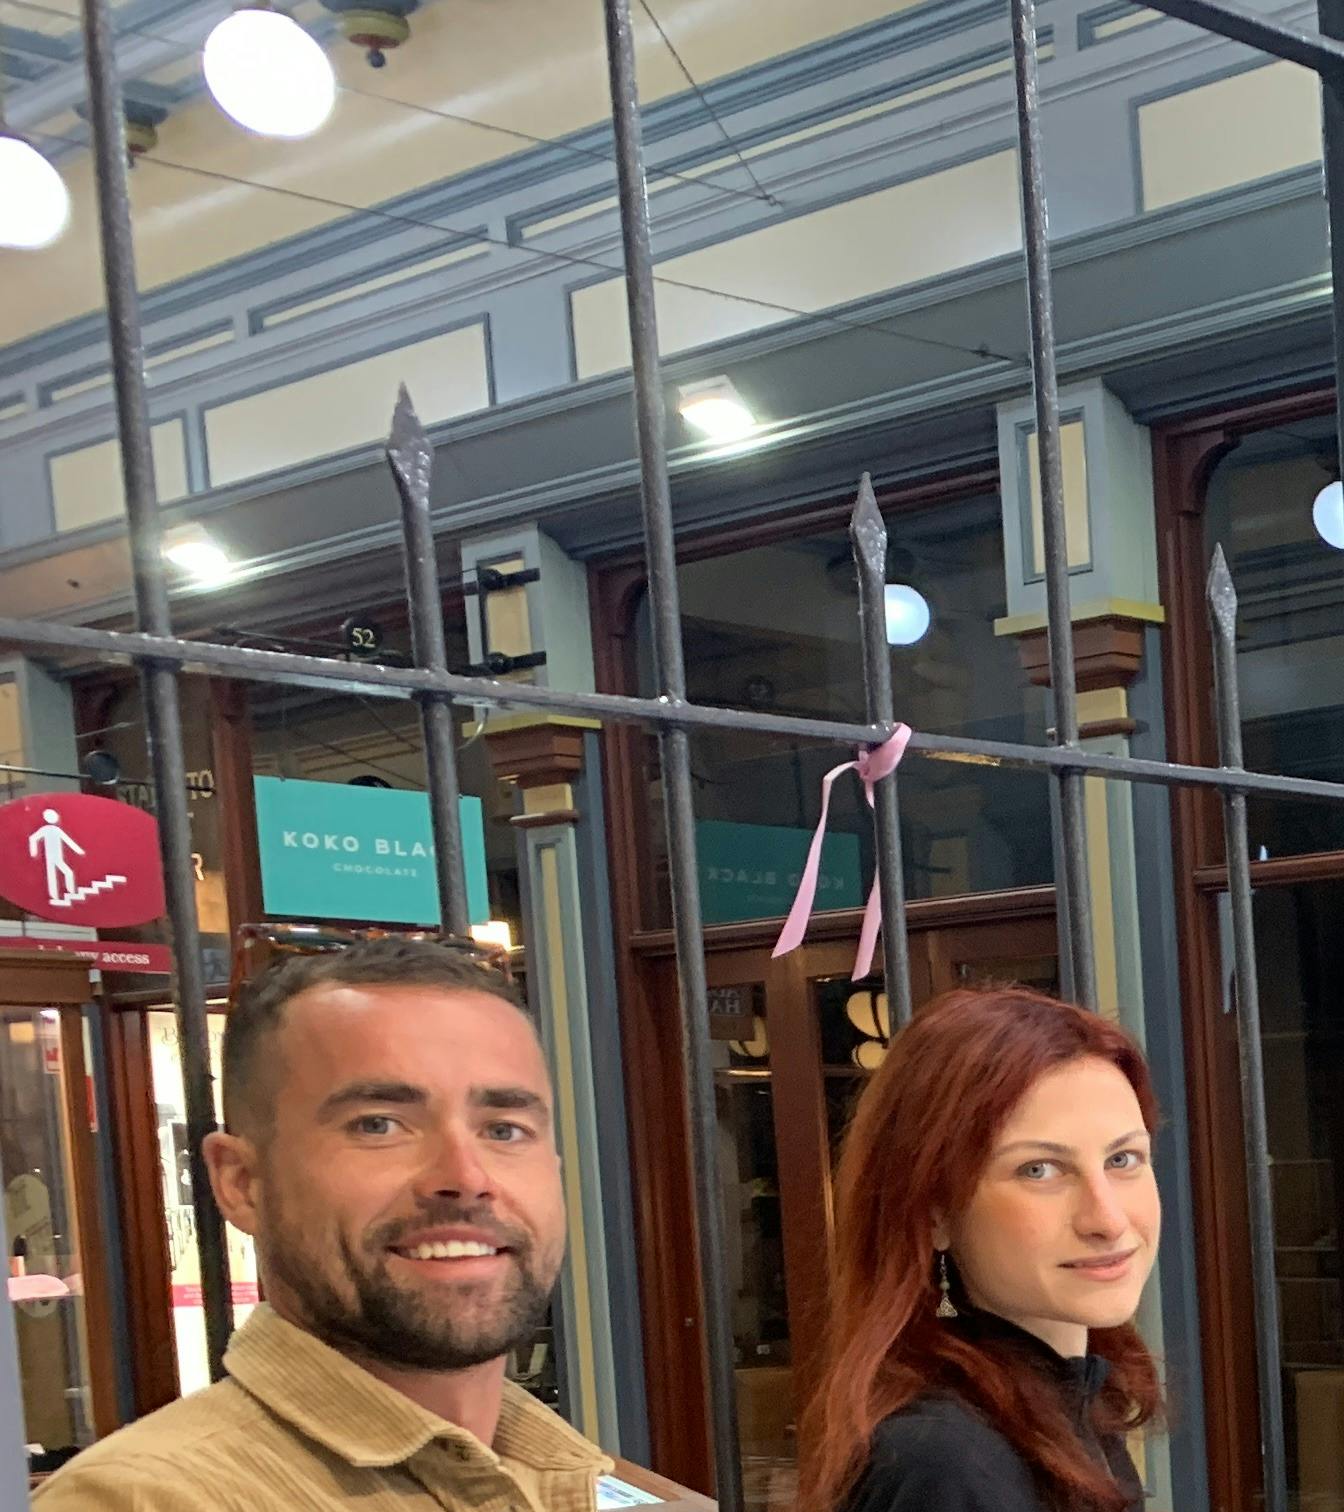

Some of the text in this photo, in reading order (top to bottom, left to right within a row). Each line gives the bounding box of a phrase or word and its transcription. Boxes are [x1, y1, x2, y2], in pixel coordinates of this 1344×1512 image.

[352, 627, 376, 648] 52
[283, 831, 438, 857] KOKO BLA
[102, 952, 150, 965] access
